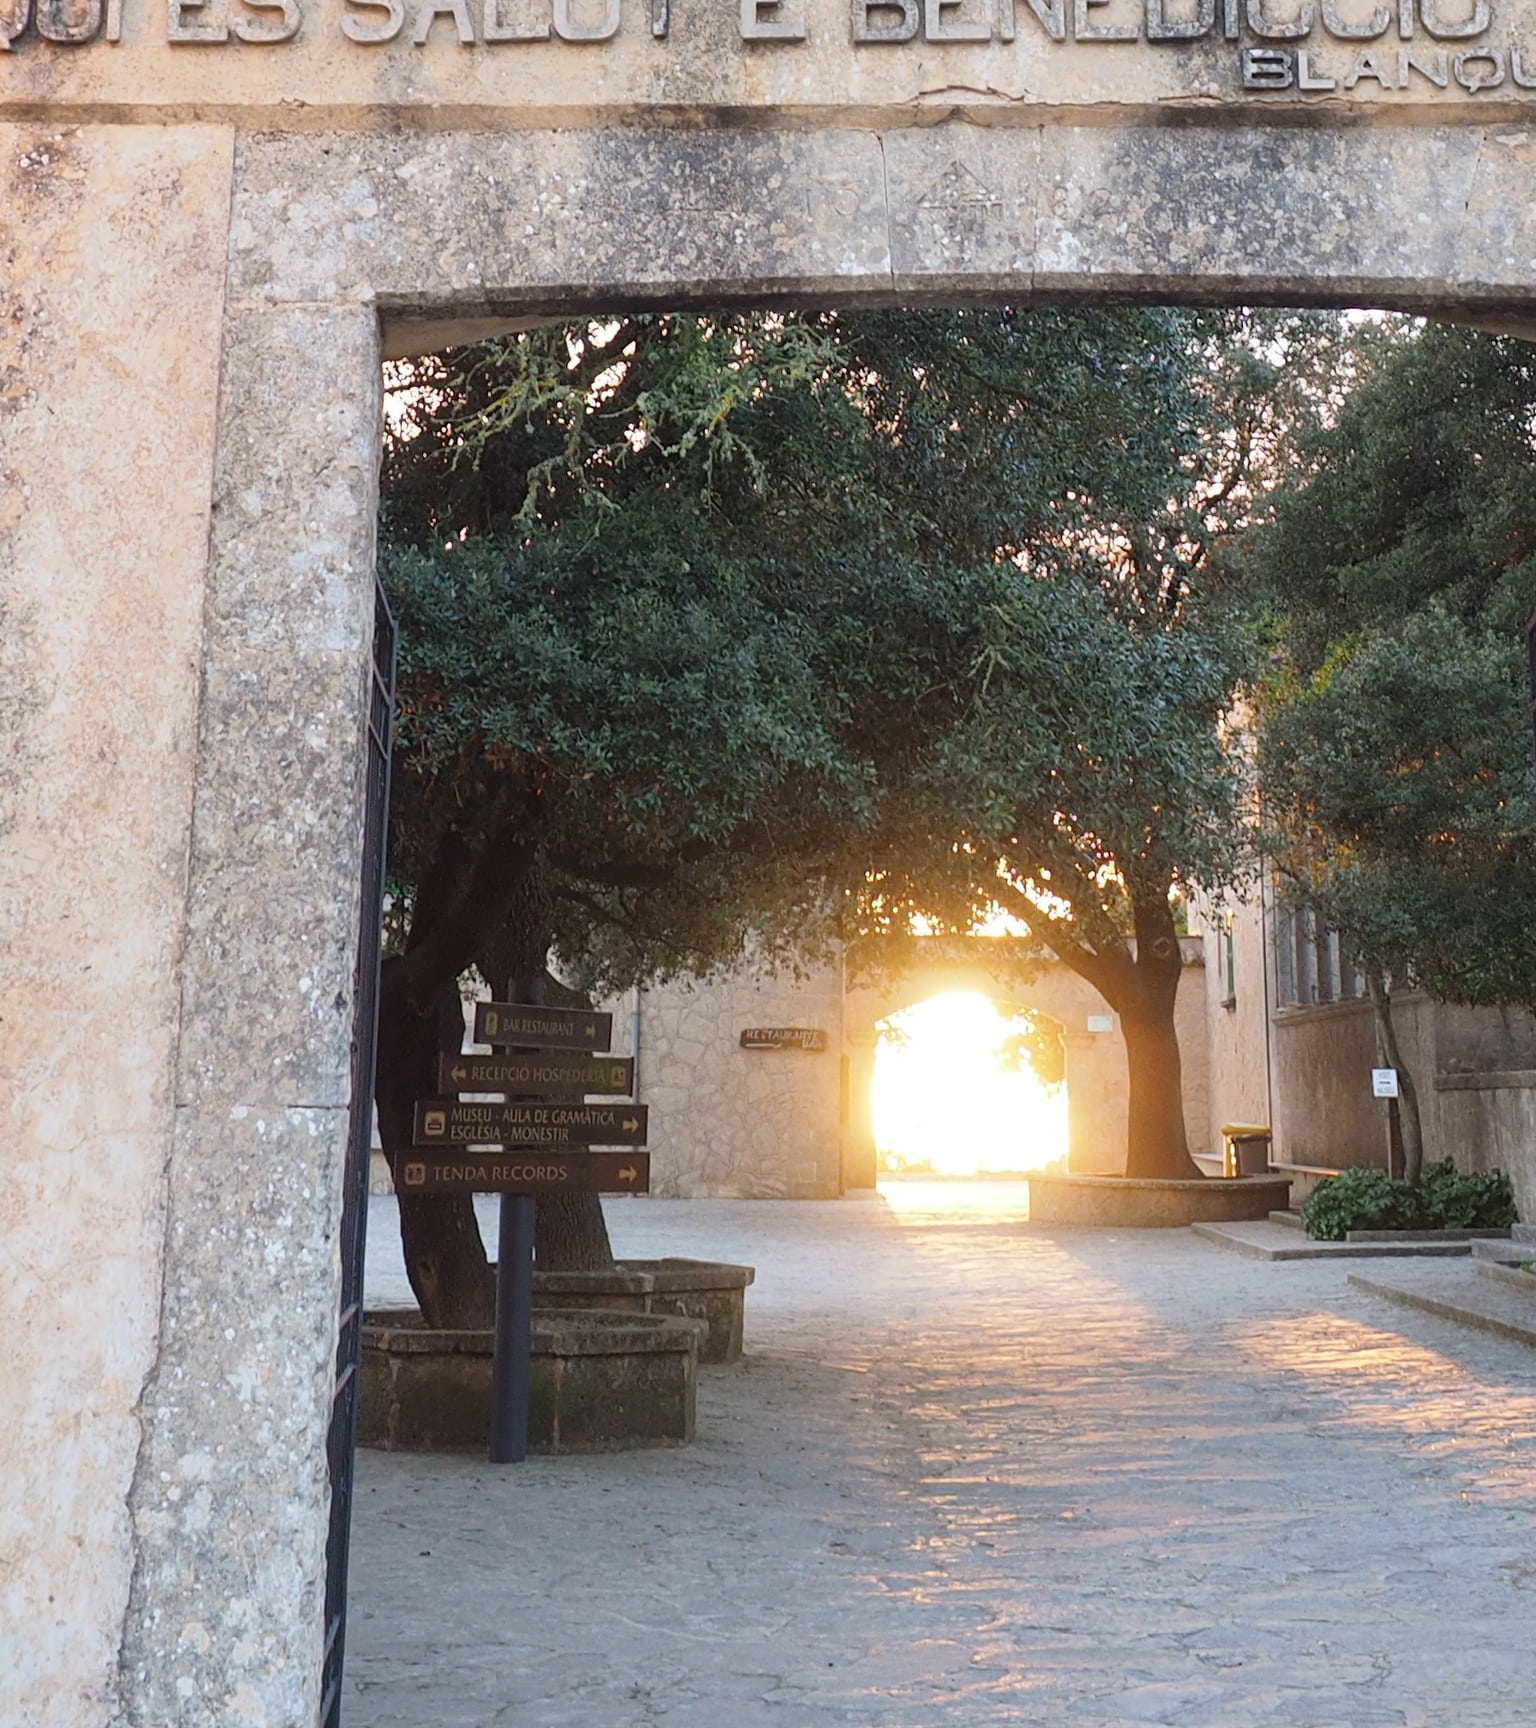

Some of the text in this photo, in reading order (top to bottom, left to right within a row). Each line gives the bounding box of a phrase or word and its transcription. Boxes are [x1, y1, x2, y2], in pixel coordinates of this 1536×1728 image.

[471, 1064, 530, 1082] RECEPCIÓ
[450, 1107, 492, 1122] MUSEU
[502, 1109, 533, 1123] AULA
[535, 1109, 549, 1123] DE
[551, 1108, 615, 1125] GRAMÀTICA
[511, 1126, 569, 1141] MONESTIR
[434, 1165, 568, 1182] TENDA RECORDS
